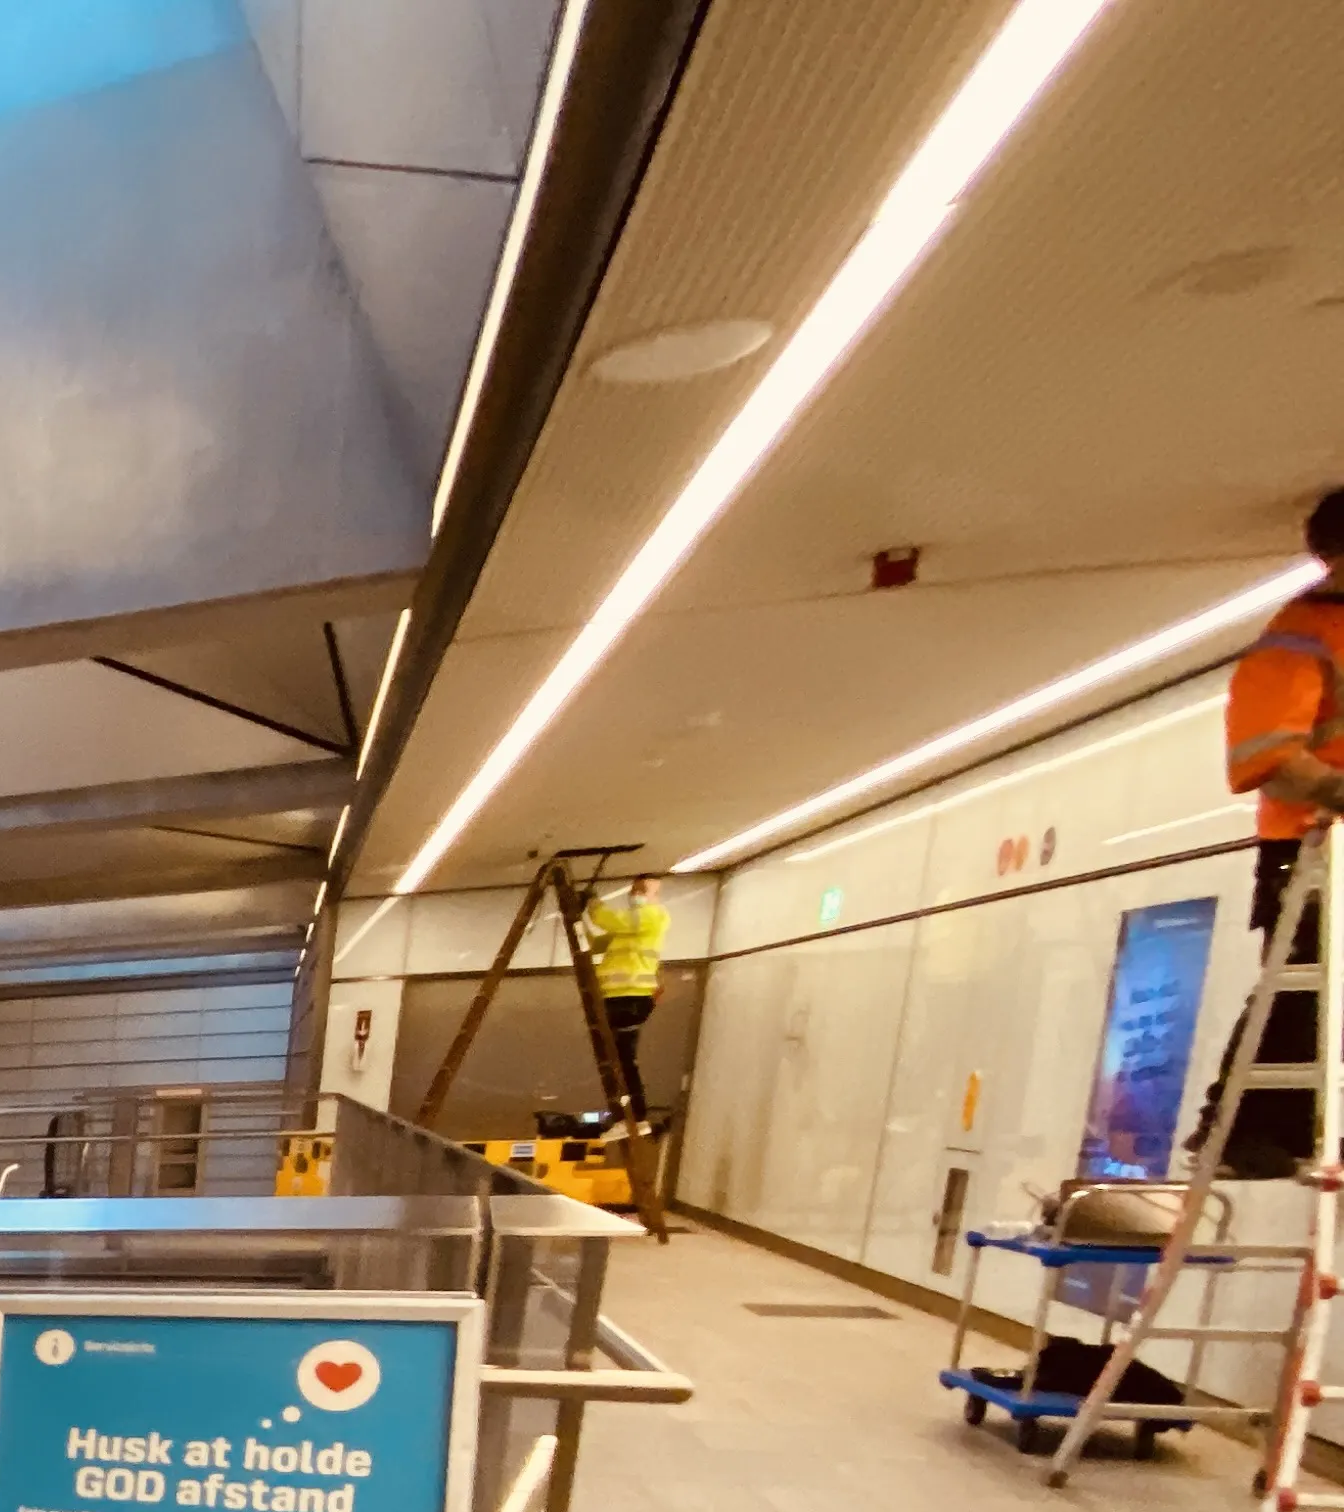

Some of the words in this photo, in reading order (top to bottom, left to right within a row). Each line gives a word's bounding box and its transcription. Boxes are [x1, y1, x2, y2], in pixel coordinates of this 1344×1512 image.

[67, 1427, 173, 1465] Husk
[183, 1436, 232, 1469] at
[242, 1437, 373, 1477] holde
[75, 1466, 166, 1503] GOD
